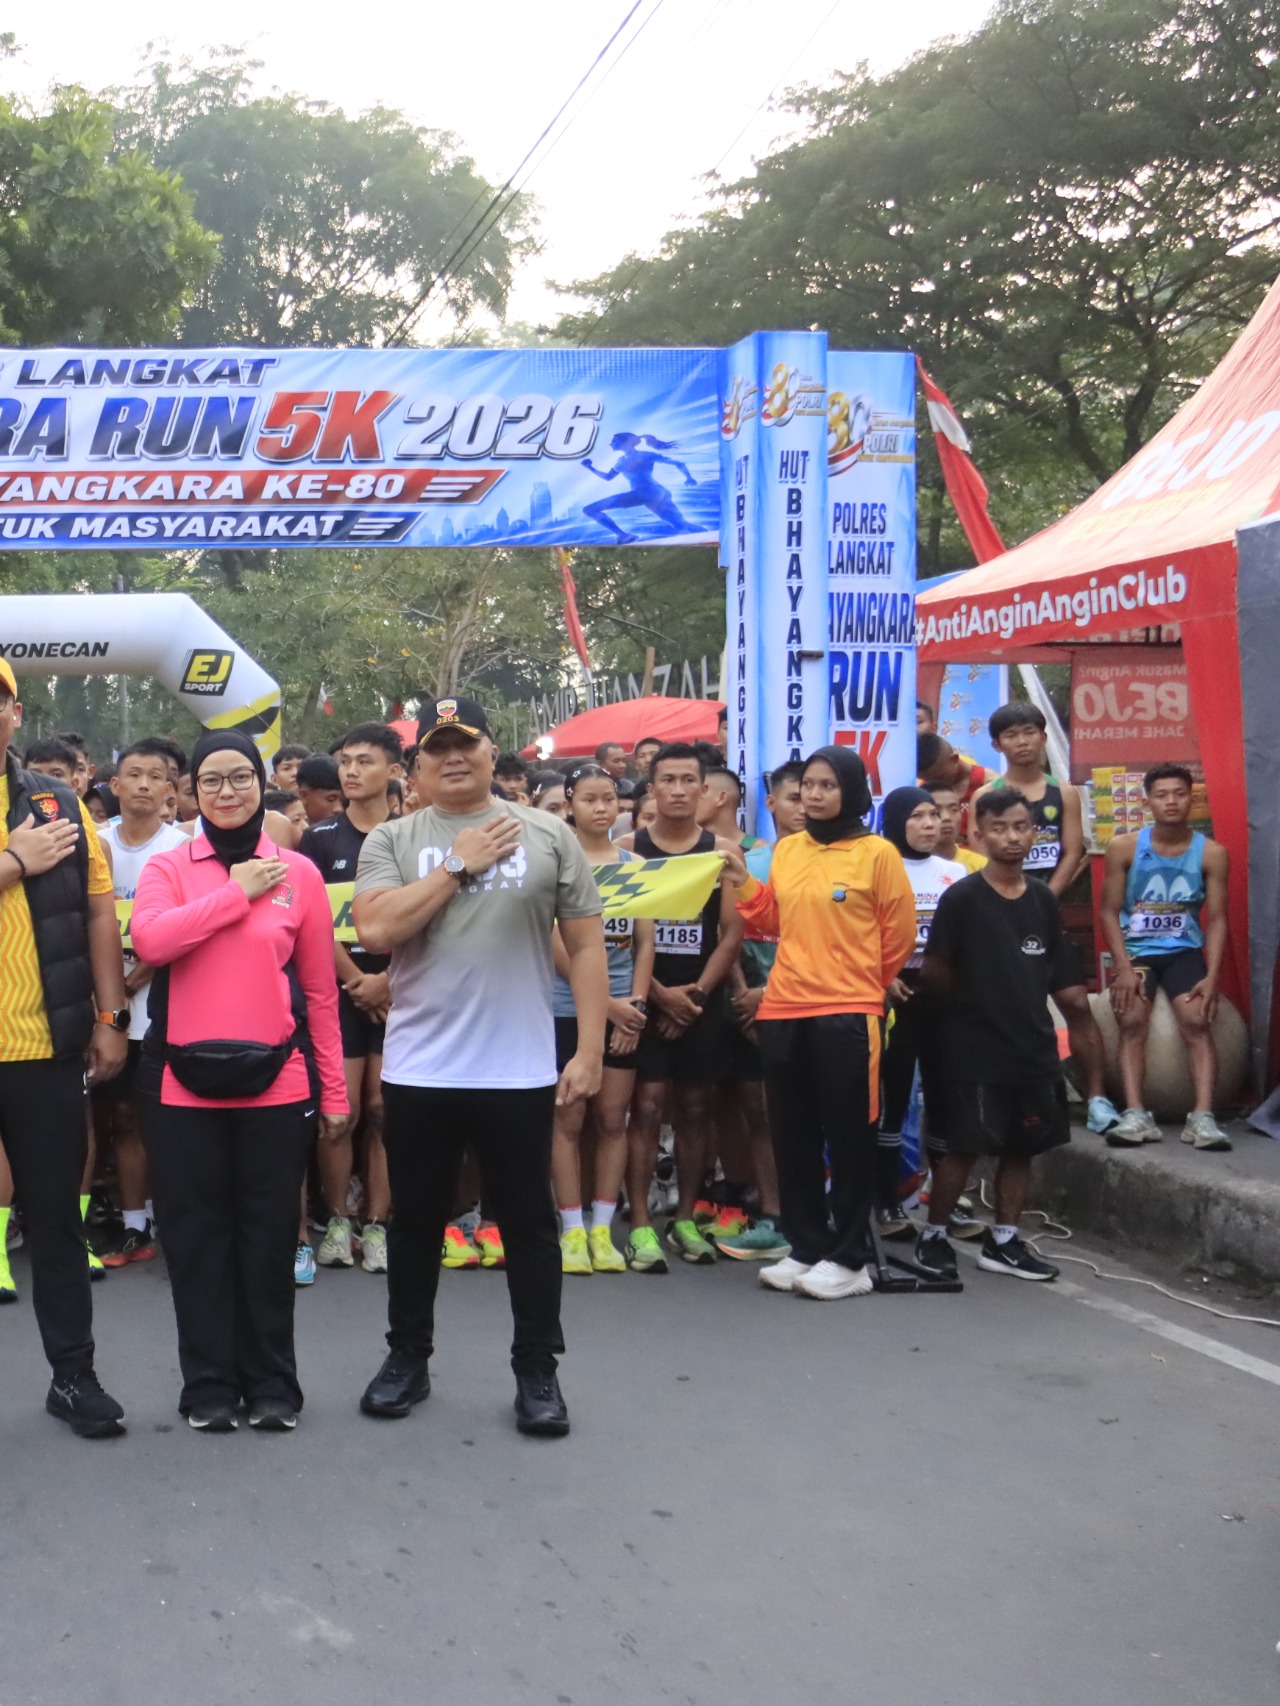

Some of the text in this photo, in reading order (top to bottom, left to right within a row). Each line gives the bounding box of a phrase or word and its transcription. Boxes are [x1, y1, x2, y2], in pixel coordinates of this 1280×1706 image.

[16, 357, 277, 388] LANGKAT
[90, 396, 263, 461] RUN
[256, 389, 398, 461] 5K
[395, 398, 602, 459] 2026
[779, 450, 809, 480] HUT
[261, 474, 406, 500] KE-80
[69, 515, 344, 539] MASYARAKAT
[832, 502, 888, 536] POLRES
[828, 540, 895, 576] LANGKAT
[915, 565, 1187, 646] #AntiAnginAnginClub
[185, 654, 232, 683] EJ
[183, 682, 223, 692] SPORT
[828, 650, 902, 722] RUN
[436, 715, 460, 725] 0203
[656, 927, 698, 944] 1185
[1142, 915, 1183, 929] 1036
